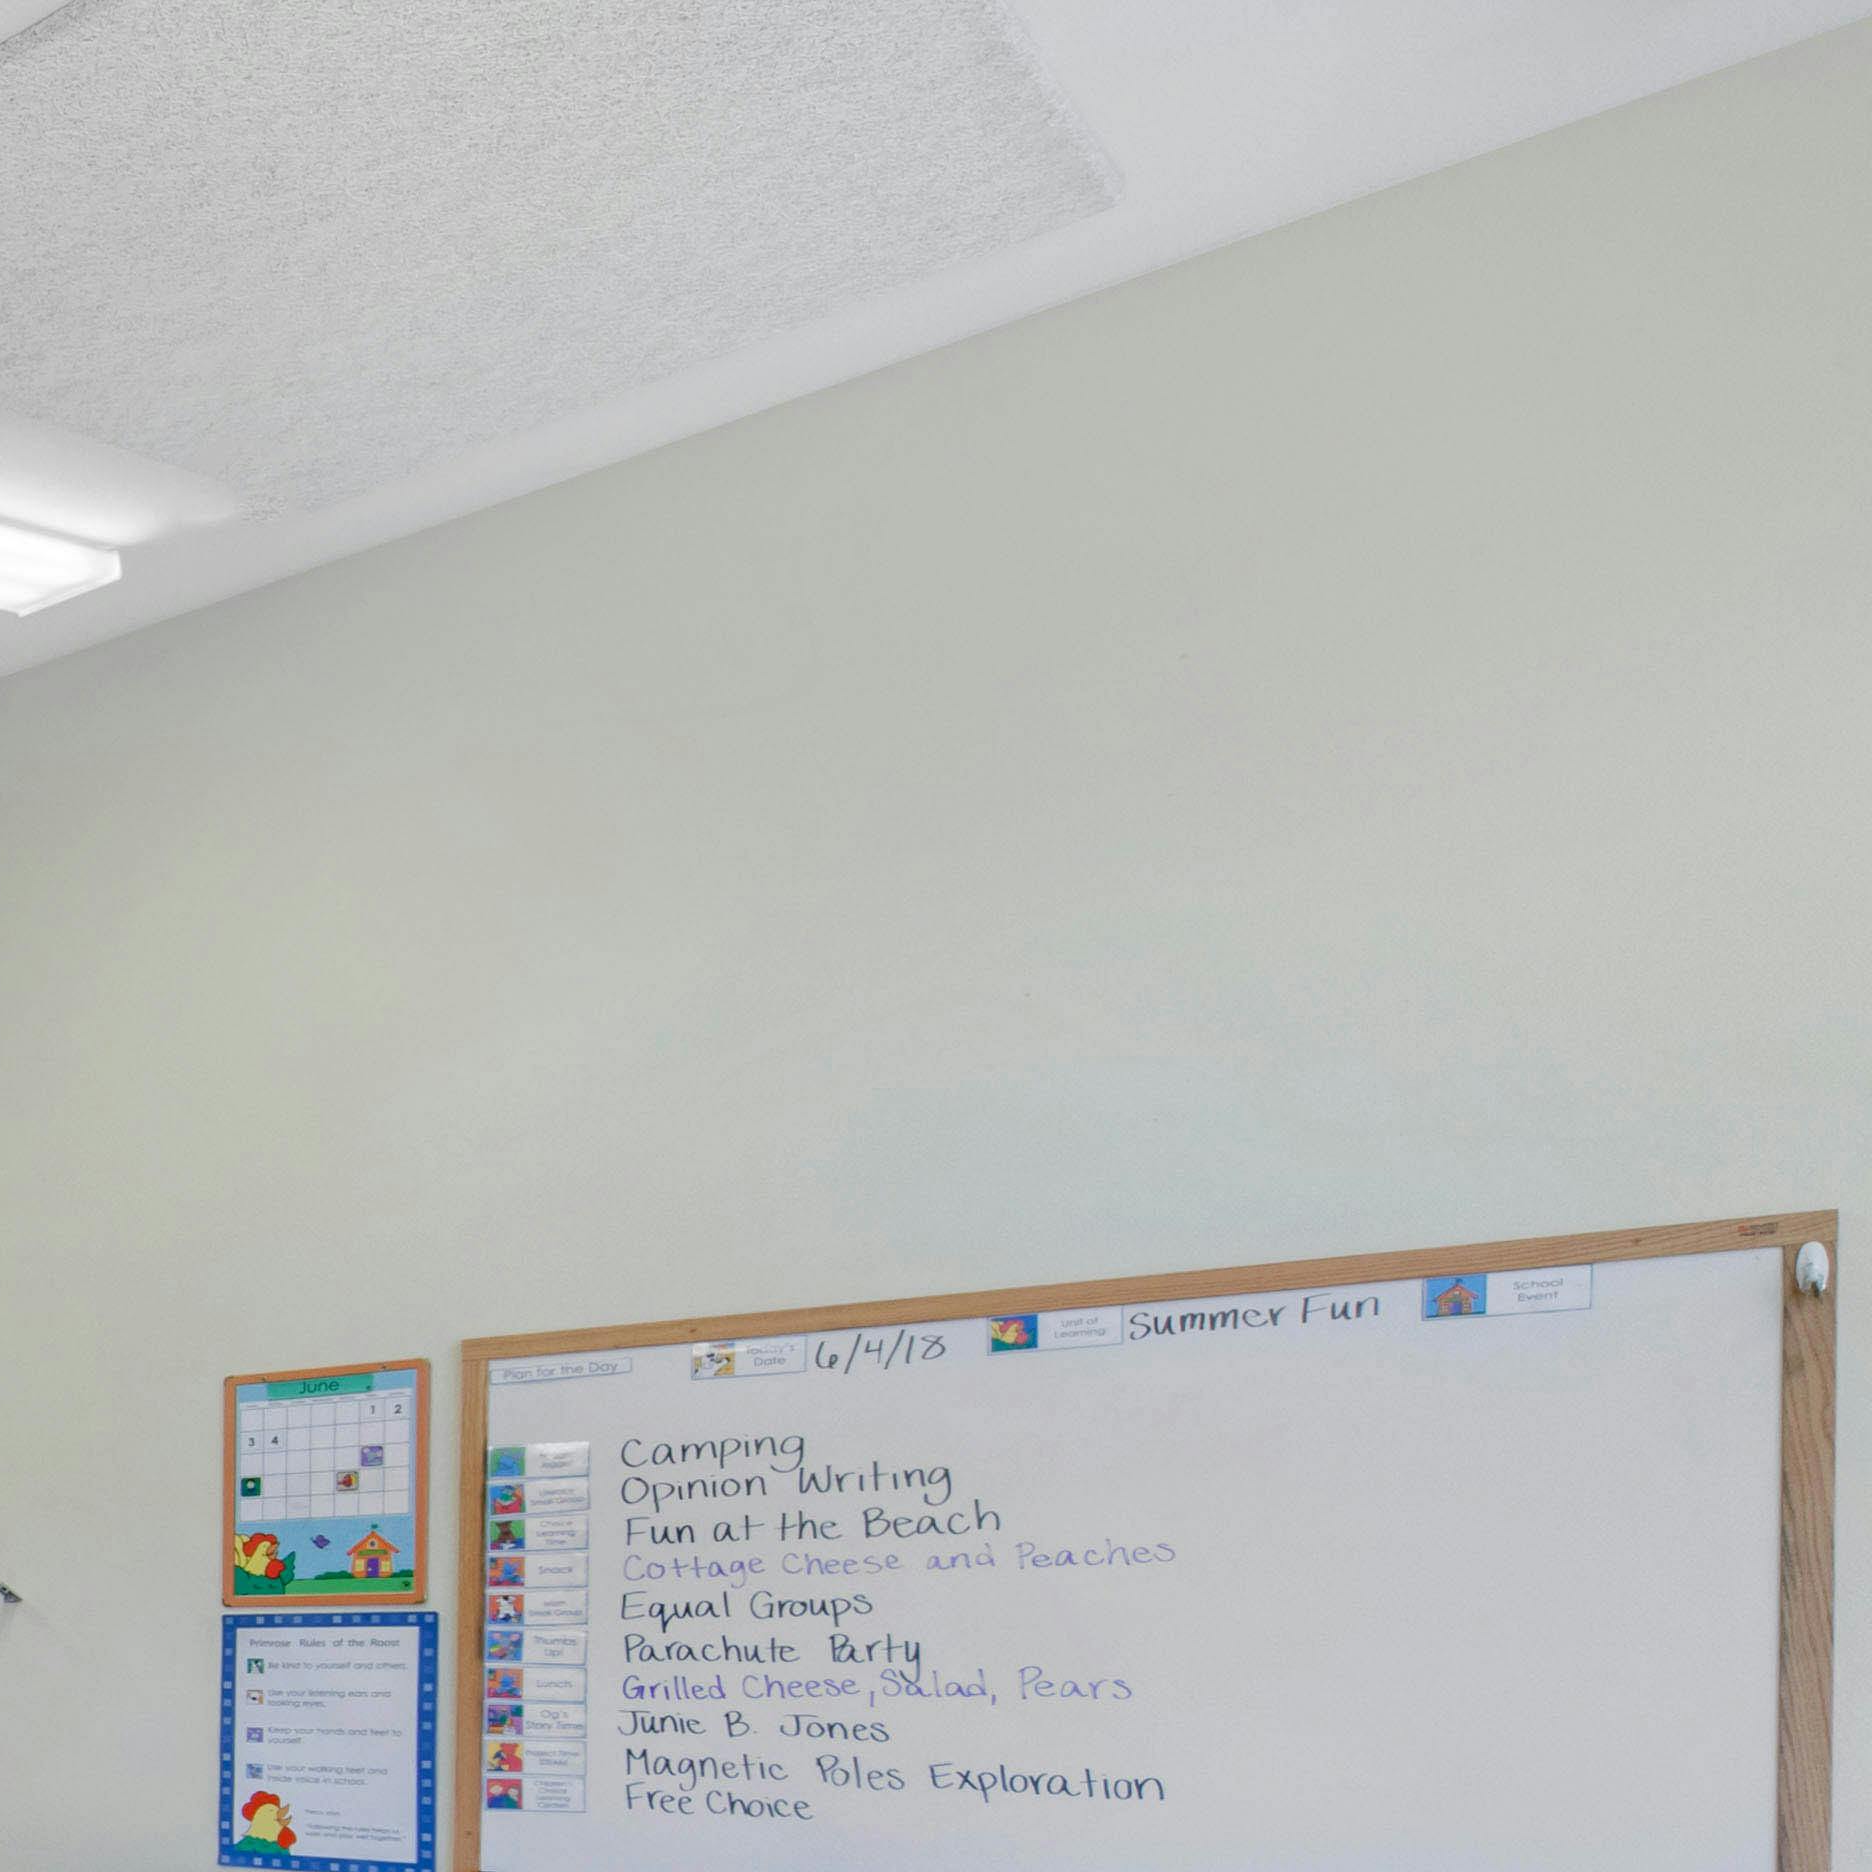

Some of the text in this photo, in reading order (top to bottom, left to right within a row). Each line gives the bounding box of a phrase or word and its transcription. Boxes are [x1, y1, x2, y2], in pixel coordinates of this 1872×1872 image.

[1512, 1278, 1564, 1291] School
[1517, 1290, 1560, 1303] Event
[1128, 1294, 1380, 1342] Summer Fun
[1053, 1326, 1106, 1340] Learning
[753, 1355, 787, 1367] Date
[814, 1329, 946, 1375] 6/4/18
[502, 1361, 618, 1381] Plan for the Day
[299, 1379, 340, 1394] June
[370, 1404, 403, 1414] 1 2
[248, 1436, 279, 1447] 3 4
[621, 1434, 805, 1473] Camping
[621, 1460, 953, 1512] Opinion Writing
[626, 1499, 1002, 1546] Fun at the Beach
[623, 1538, 1176, 1588] Cottage Cheese and Peaches
[621, 1590, 873, 1633] Equal Groups
[299, 1638, 326, 1648] Rules
[333, 1637, 344, 1648] of
[348, 1638, 365, 1647] the
[315, 1661, 353, 1672] yourself
[356, 1662, 373, 1670] and
[623, 1633, 921, 1682] Parachute Party
[622, 1675, 727, 1700] Grilled
[1018, 1665, 1133, 1700] Pears
[371, 1689, 392, 1698] and
[349, 1728, 368, 1736] and
[617, 1710, 707, 1736] Junie
[779, 1714, 891, 1743] Jones
[368, 1767, 389, 1775] and
[626, 1749, 1165, 1804] Magnetic Poles Exploration
[625, 1781, 816, 1821] Free Choice
